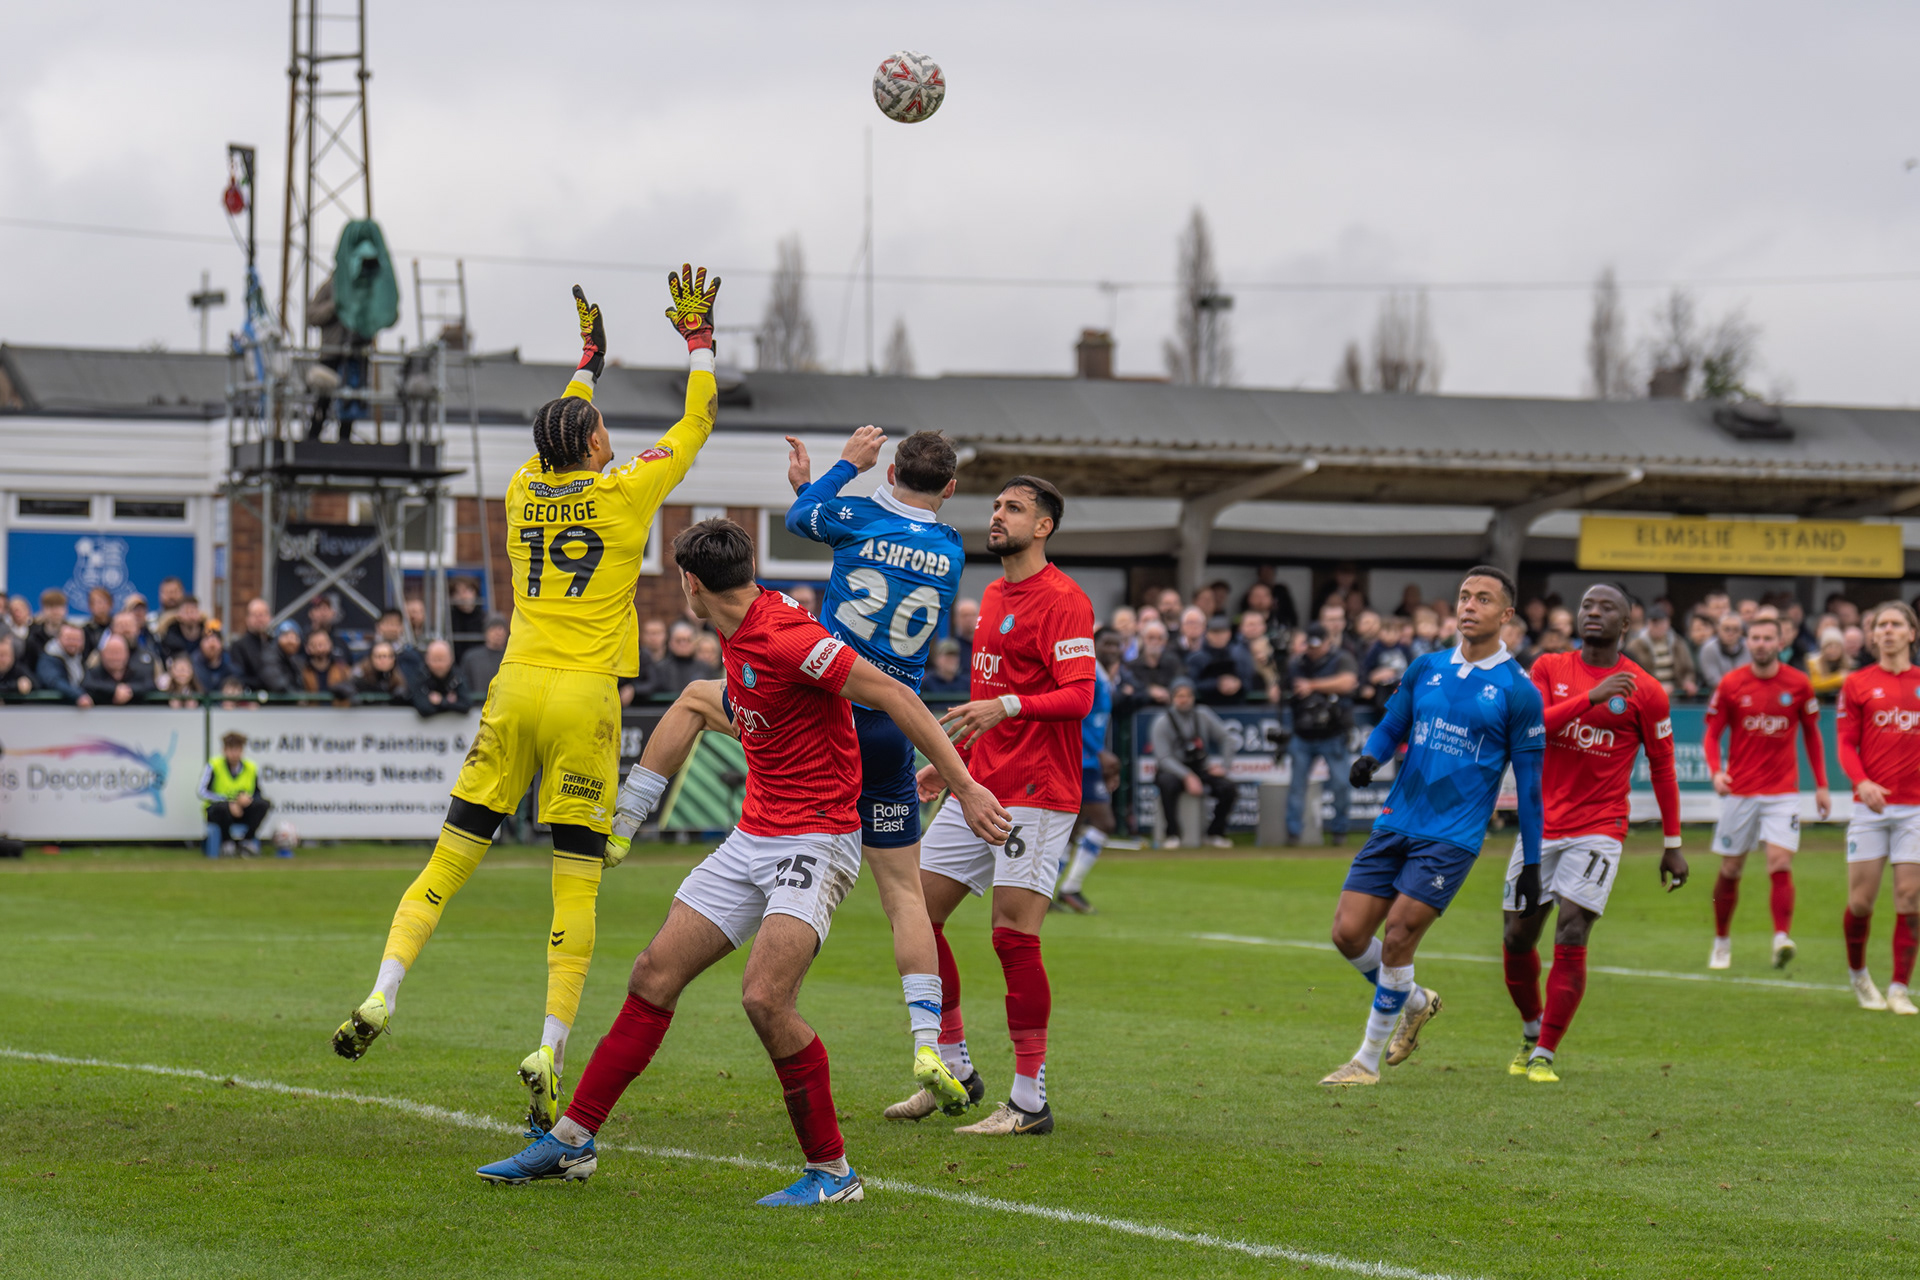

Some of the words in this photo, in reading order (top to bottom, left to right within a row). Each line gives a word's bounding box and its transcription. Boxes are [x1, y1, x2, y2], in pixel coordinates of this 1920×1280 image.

[523, 500, 598, 523] GEORGE
[1636, 525, 1733, 548] ELMSLIE
[1763, 527, 1847, 552] STAND
[520, 526, 604, 597] 19
[858, 537, 951, 578] ASHFORD
[834, 567, 941, 658] 20
[805, 641, 837, 675] Kress
[1058, 643, 1090, 656] Kress
[1435, 717, 1469, 738] Brunel
[1744, 712, 1789, 735] origin
[278, 734, 305, 751] All
[309, 734, 356, 751] Your
[361, 734, 449, 756] Painting
[1429, 740, 1463, 757] London
[1432, 728, 1477, 753] University
[26, 763, 166, 791] Decorators
[261, 764, 377, 785] Decorating
[381, 764, 444, 781] Needs
[562, 773, 591, 787] CHERRY
[590, 779, 604, 790] RED
[560, 782, 601, 801] RECORDS
[873, 803, 910, 818] Rolfe
[873, 817, 905, 833] East
[1003, 825, 1027, 859] 6
[774, 854, 818, 890] 25
[1583, 849, 1611, 888] 11
